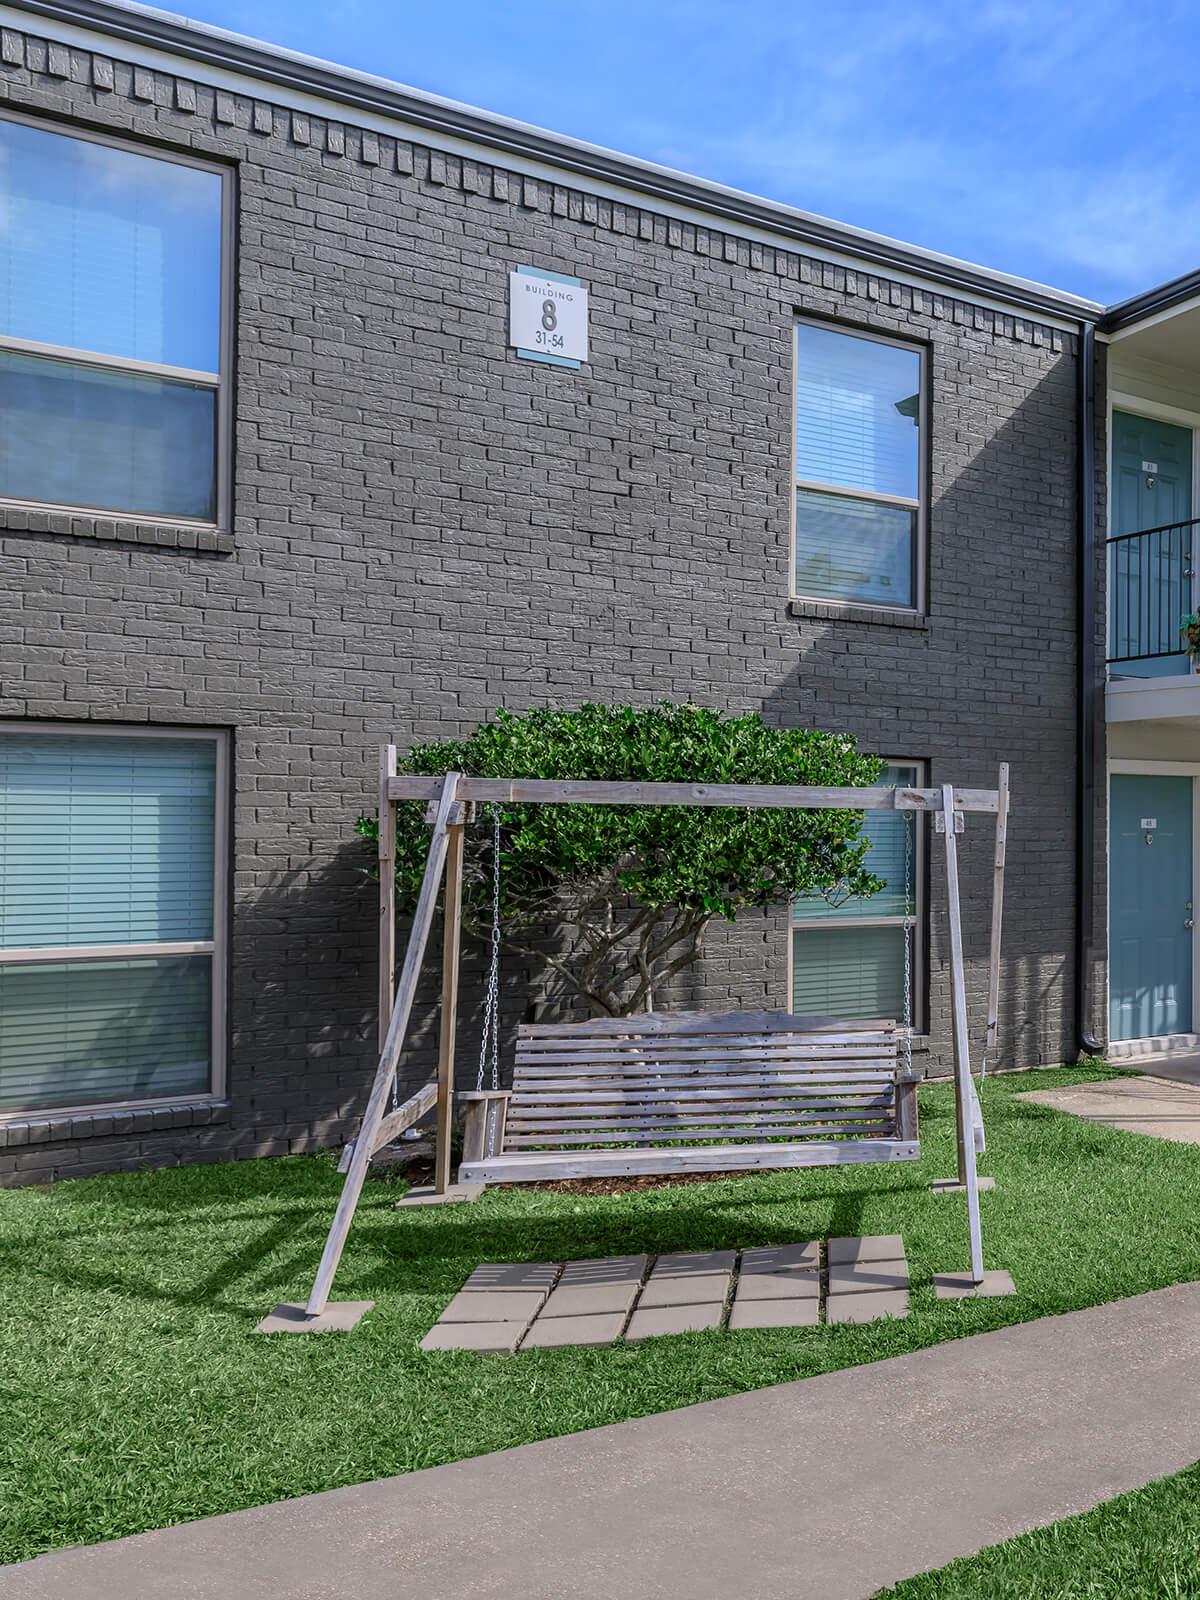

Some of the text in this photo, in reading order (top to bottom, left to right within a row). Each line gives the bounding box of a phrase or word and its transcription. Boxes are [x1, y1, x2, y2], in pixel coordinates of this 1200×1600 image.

[525, 284, 574, 301] BUILDING
[542, 299, 557, 331] 8
[535, 330, 564, 348] 31-54
